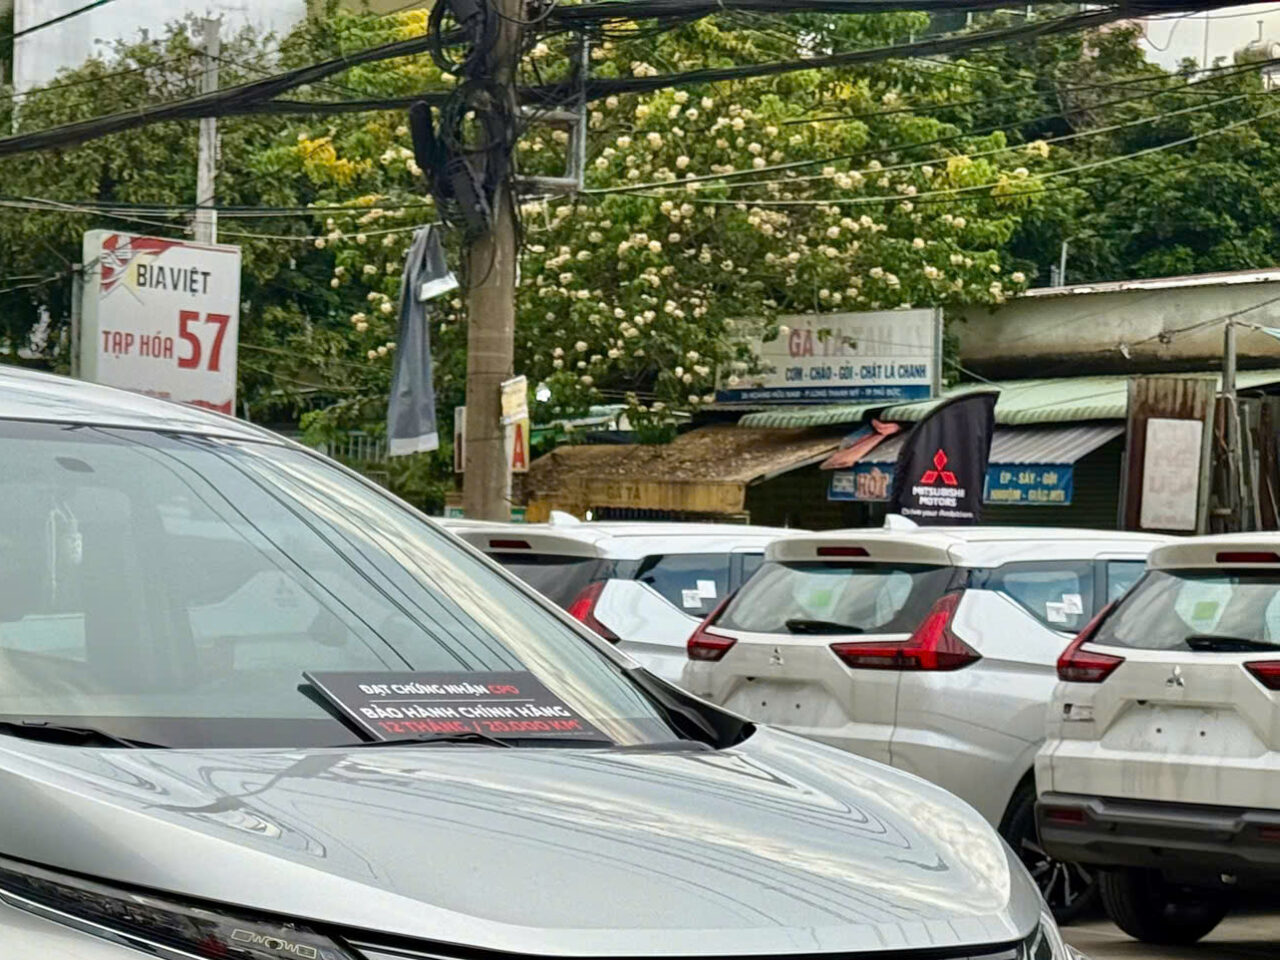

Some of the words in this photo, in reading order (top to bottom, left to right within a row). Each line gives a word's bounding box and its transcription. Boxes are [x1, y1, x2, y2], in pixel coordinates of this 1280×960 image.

[136, 264, 167, 290] BIA
[169, 266, 211, 297] VIỆT
[102, 330, 134, 359] TẠP
[140, 331, 174, 359] HÓA
[177, 310, 231, 372] 57
[788, 320, 814, 357] GÀ
[898, 363, 926, 379] CHANH
[912, 485, 965, 498] MITSUBISHI
[919, 496, 957, 507] MOTORS
[359, 684, 391, 696] ĐẠT
[390, 682, 446, 695] CHỨNG
[442, 682, 490, 696] NHẬN
[360, 704, 404, 718] BẢO
[400, 704, 460, 718] HÀNH
[458, 704, 519, 718] CHÍNH
[514, 704, 572, 717] HÃNG
